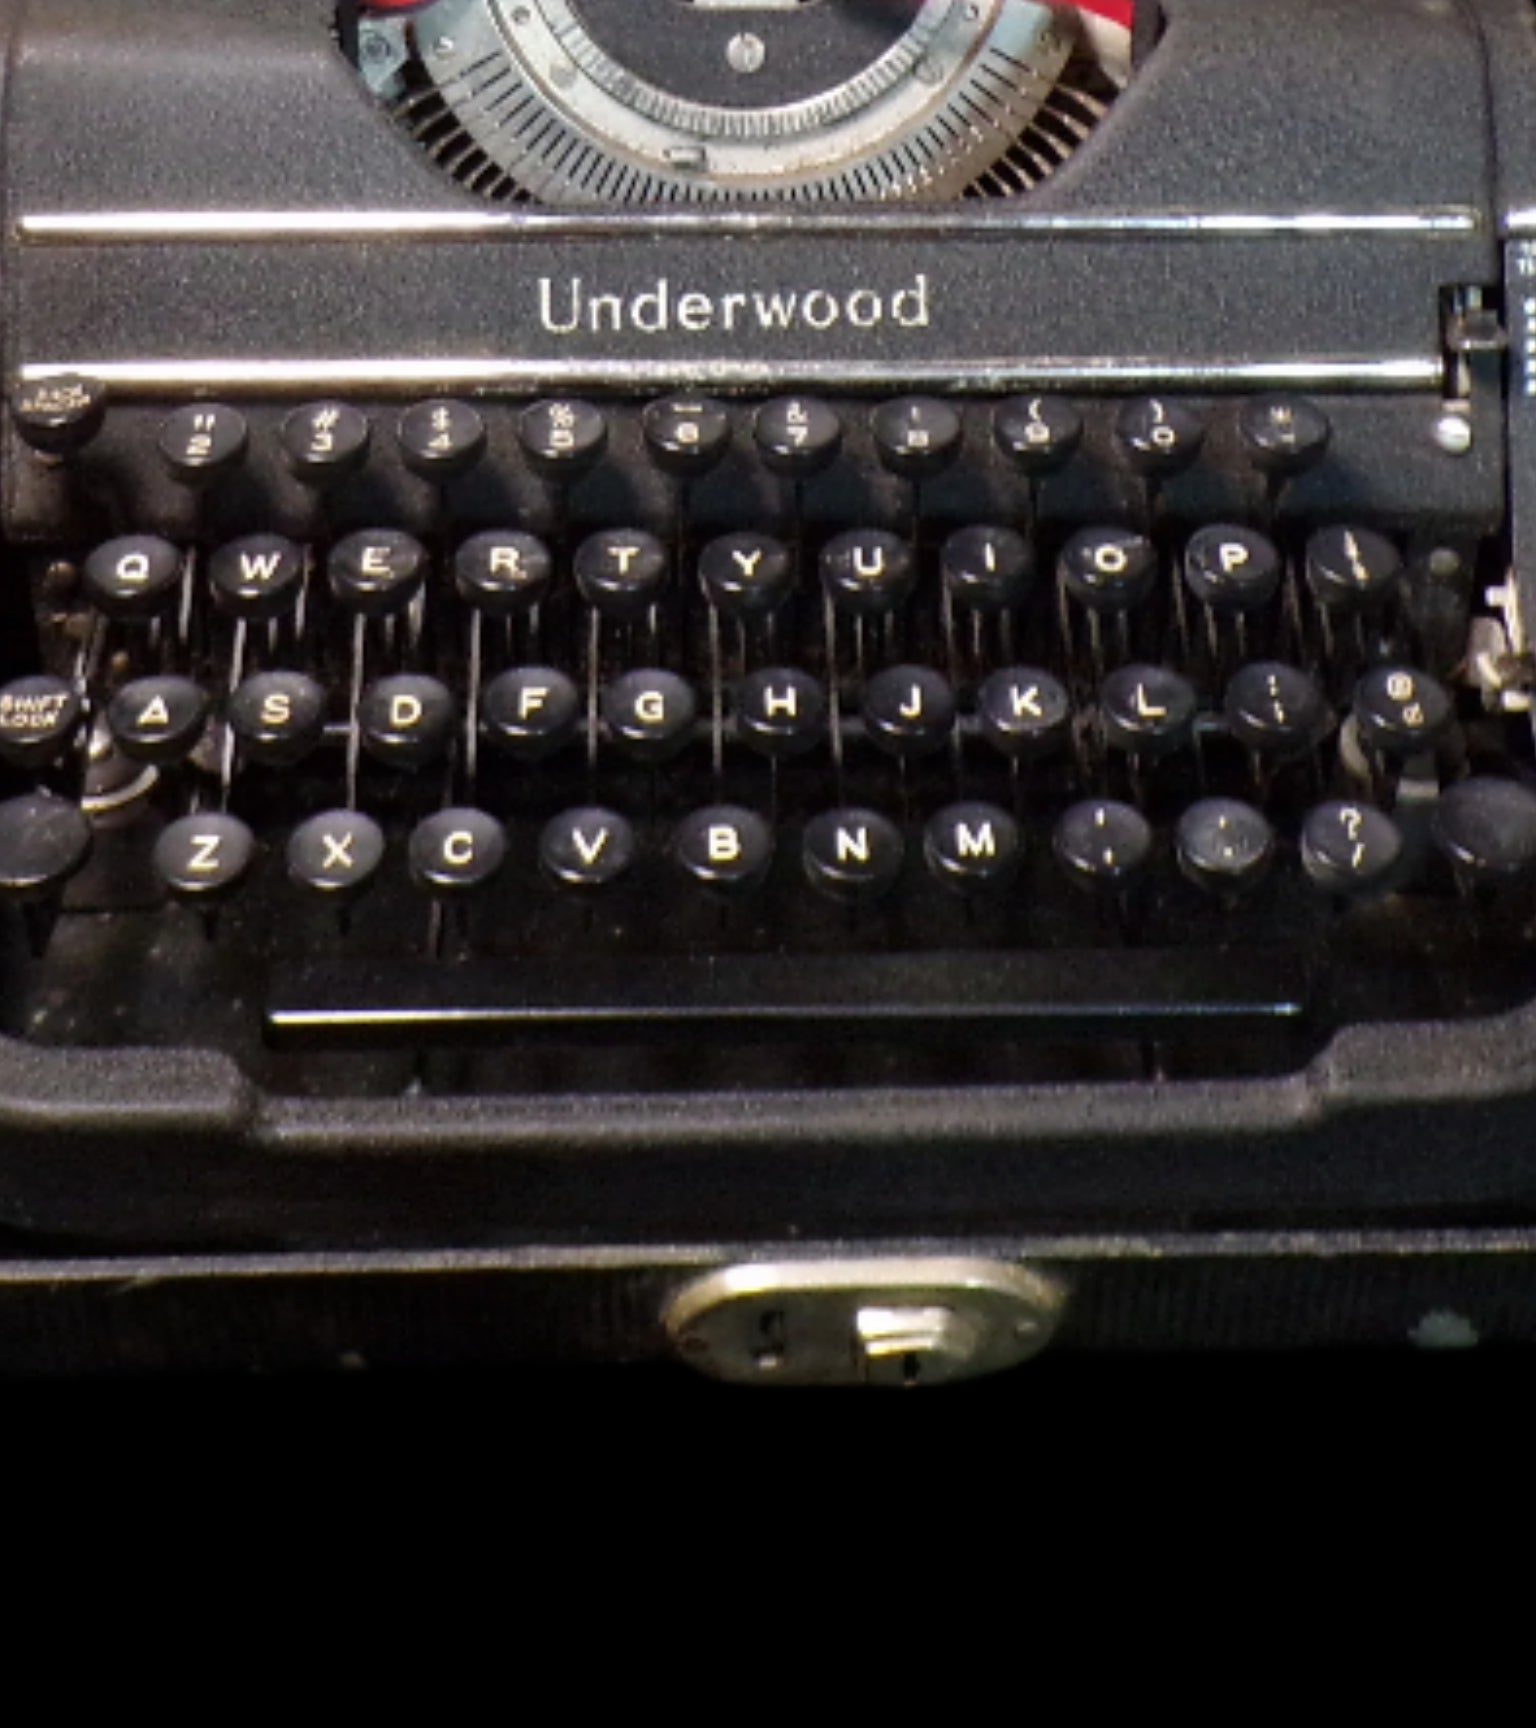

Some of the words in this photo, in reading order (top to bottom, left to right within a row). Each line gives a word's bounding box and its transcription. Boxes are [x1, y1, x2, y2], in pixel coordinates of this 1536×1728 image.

[537, 273, 930, 334] Underwood
[186, 434, 212, 455] 2
[311, 430, 333, 452] 3
[427, 429, 452, 450] 4
[116, 553, 150, 582] Q
[240, 553, 282, 580] W
[361, 546, 391, 574] E
[490, 546, 523, 574] R
[609, 546, 640, 573] T
[732, 550, 762, 576] Y
[853, 547, 884, 576] U
[985, 543, 995, 571] I
[1094, 543, 1128, 572] O
[1219, 543, 1249, 571] P
[137, 695, 170, 724] A
[261, 692, 291, 724] S
[389, 694, 423, 726] D
[519, 686, 549, 718] F
[634, 690, 665, 722] G
[764, 686, 797, 716] H
[899, 685, 922, 717] J
[1010, 686, 1043, 716] K
[1136, 683, 1166, 716] L
[188, 834, 221, 870] Z
[322, 832, 353, 868] X
[443, 830, 474, 864] C
[572, 828, 608, 863] V
[708, 825, 740, 860] B
[835, 827, 868, 862] N
[955, 822, 996, 857] M
